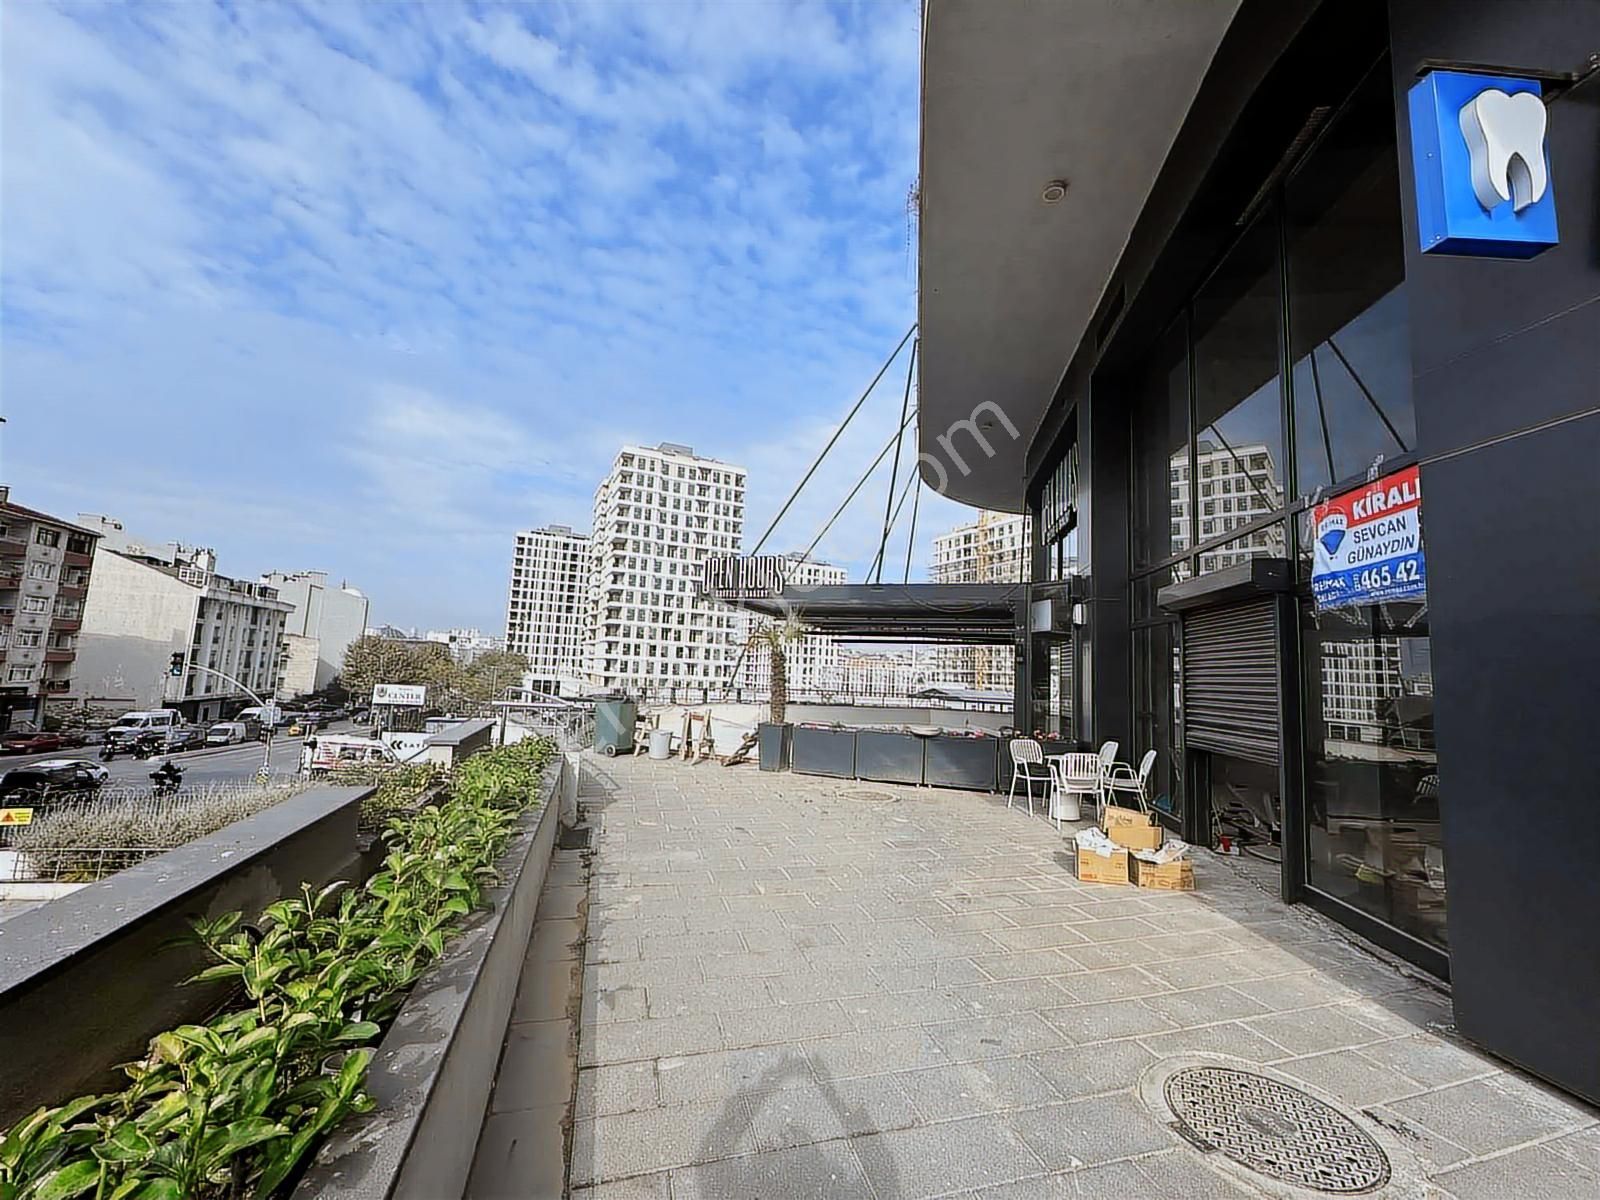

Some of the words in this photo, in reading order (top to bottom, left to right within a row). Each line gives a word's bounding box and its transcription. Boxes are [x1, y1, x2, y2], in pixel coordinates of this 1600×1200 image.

[1353, 516, 1406, 544] SEVCAN
[1347, 534, 1415, 564] GÜNAYDIN
[702, 557, 734, 594] OPEN
[738, 555, 784, 594] HOURS
[1361, 564, 1391, 589] 465
[1396, 559, 1420, 582] 42
